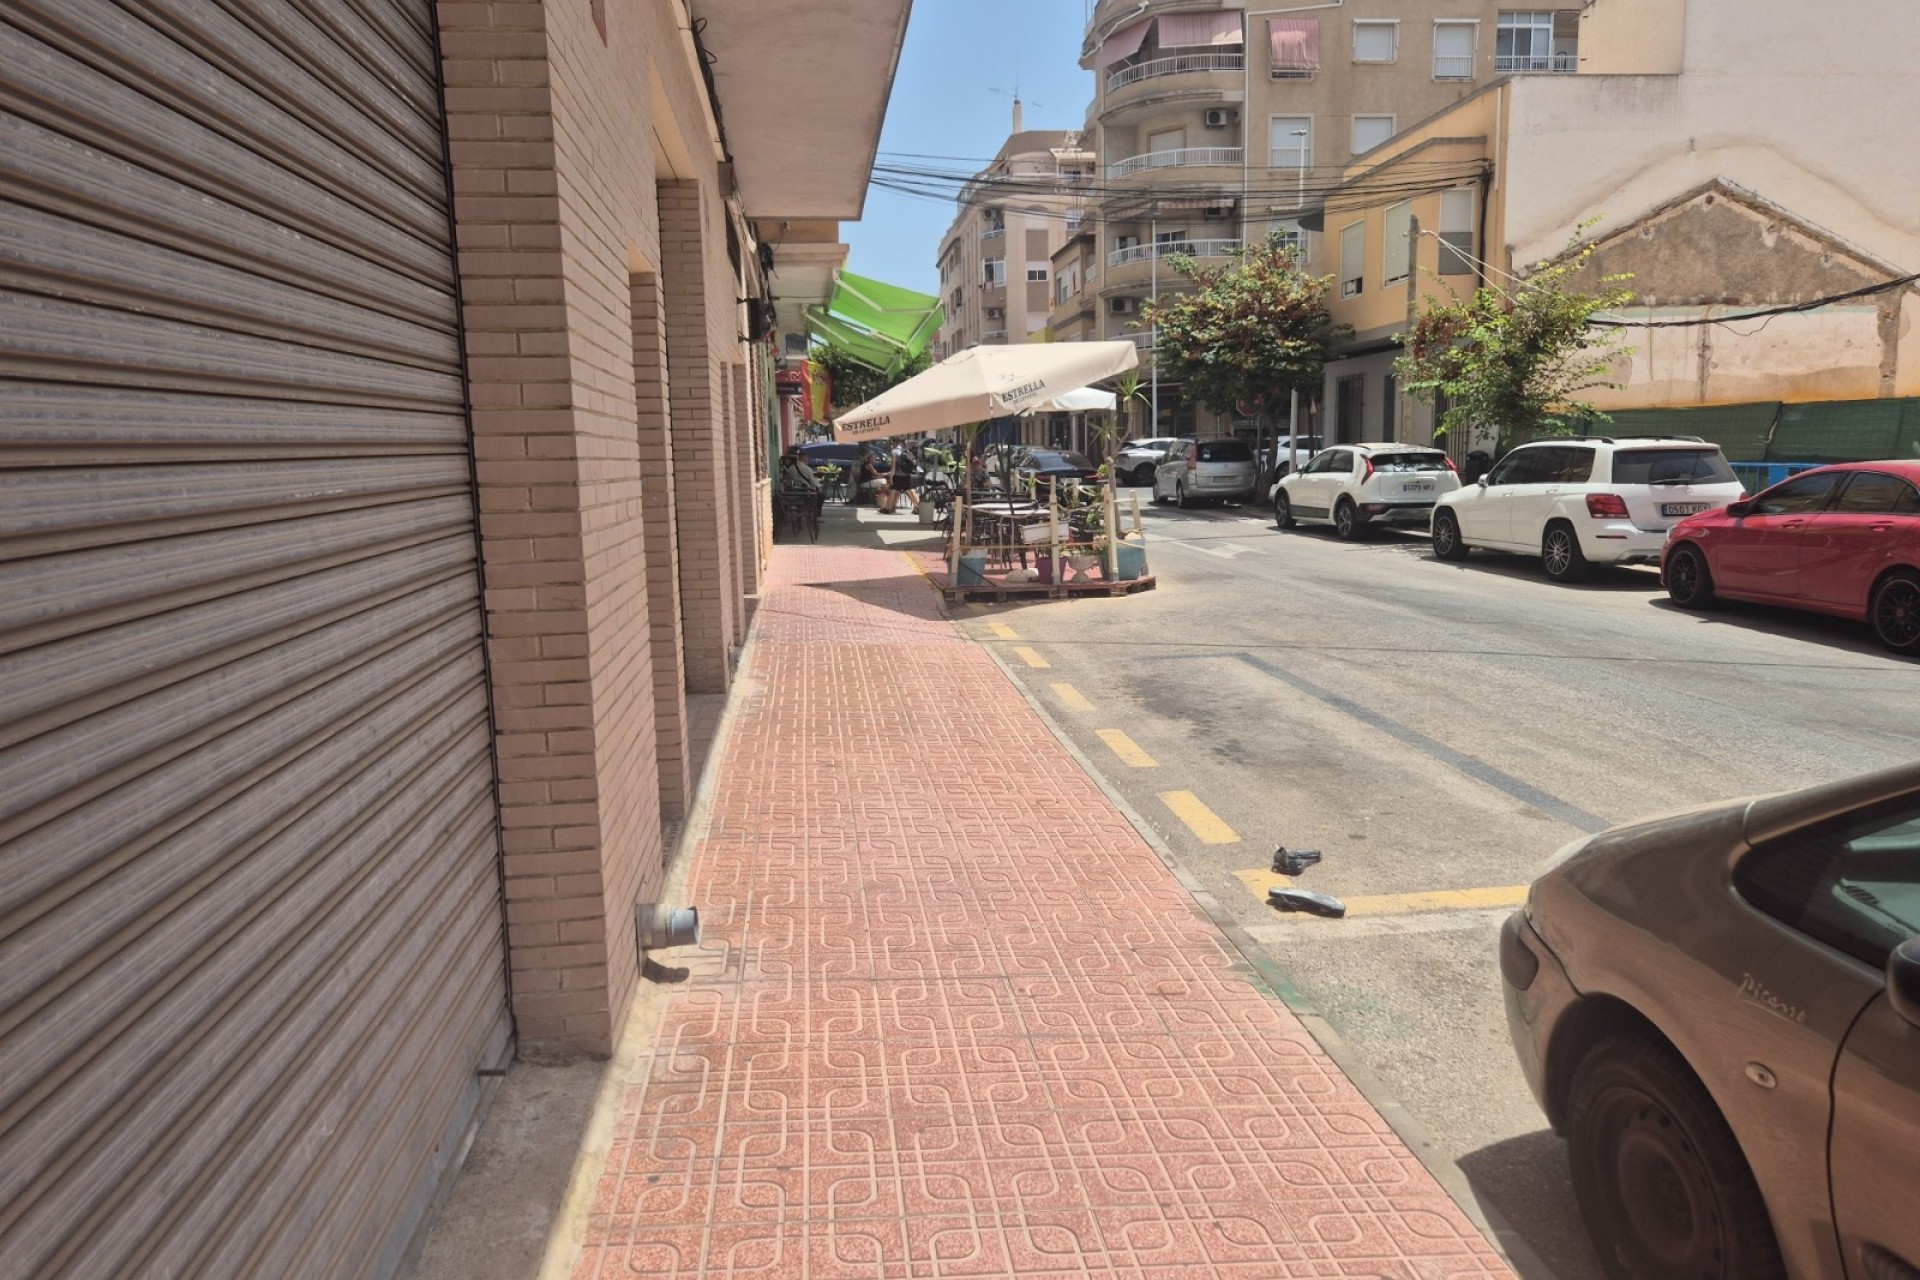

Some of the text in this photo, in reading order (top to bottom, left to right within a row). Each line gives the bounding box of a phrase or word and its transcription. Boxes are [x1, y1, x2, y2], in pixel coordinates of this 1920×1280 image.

[1002, 379, 1045, 403] ESTRELLA
[842, 415, 890, 431] ESTRELLA
[1735, 972, 1806, 1022] Picasso
